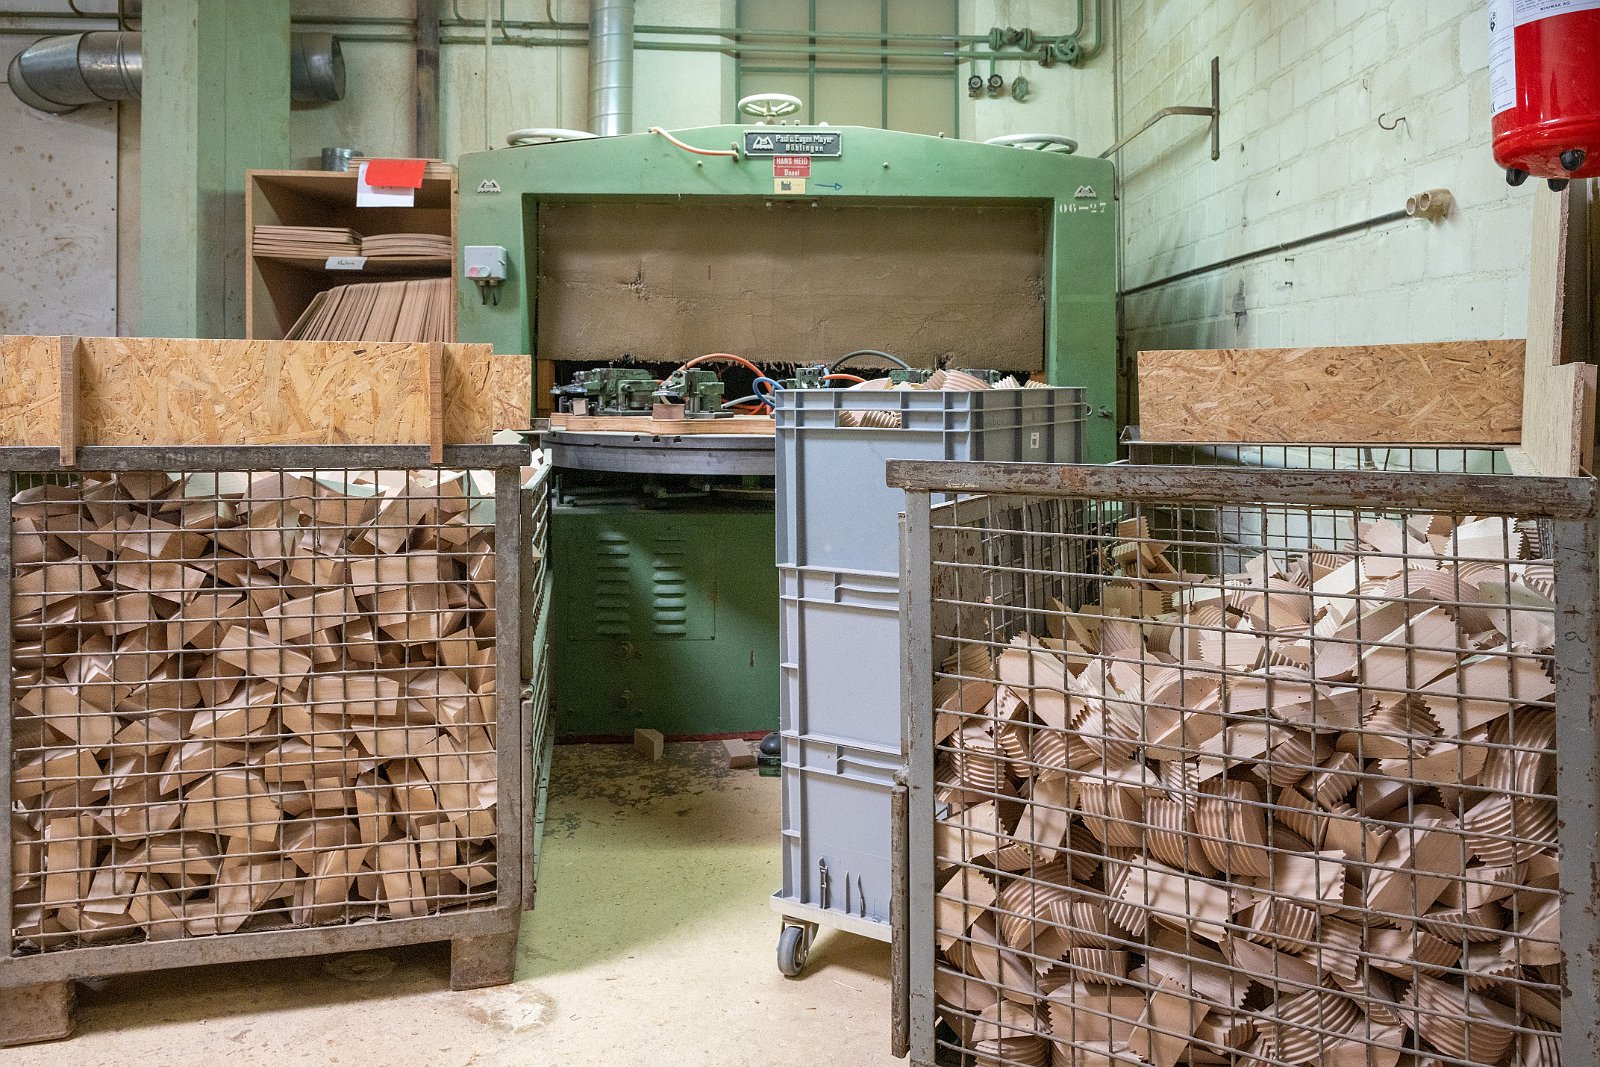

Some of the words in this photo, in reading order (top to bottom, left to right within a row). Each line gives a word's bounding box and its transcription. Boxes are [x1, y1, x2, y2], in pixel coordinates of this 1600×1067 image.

[775, 134, 789, 143] Paul
[794, 134, 812, 144] Eugen
[813, 134, 834, 144] Mayer
[785, 144, 824, 153] Böblingen
[776, 157, 793, 165] HANS
